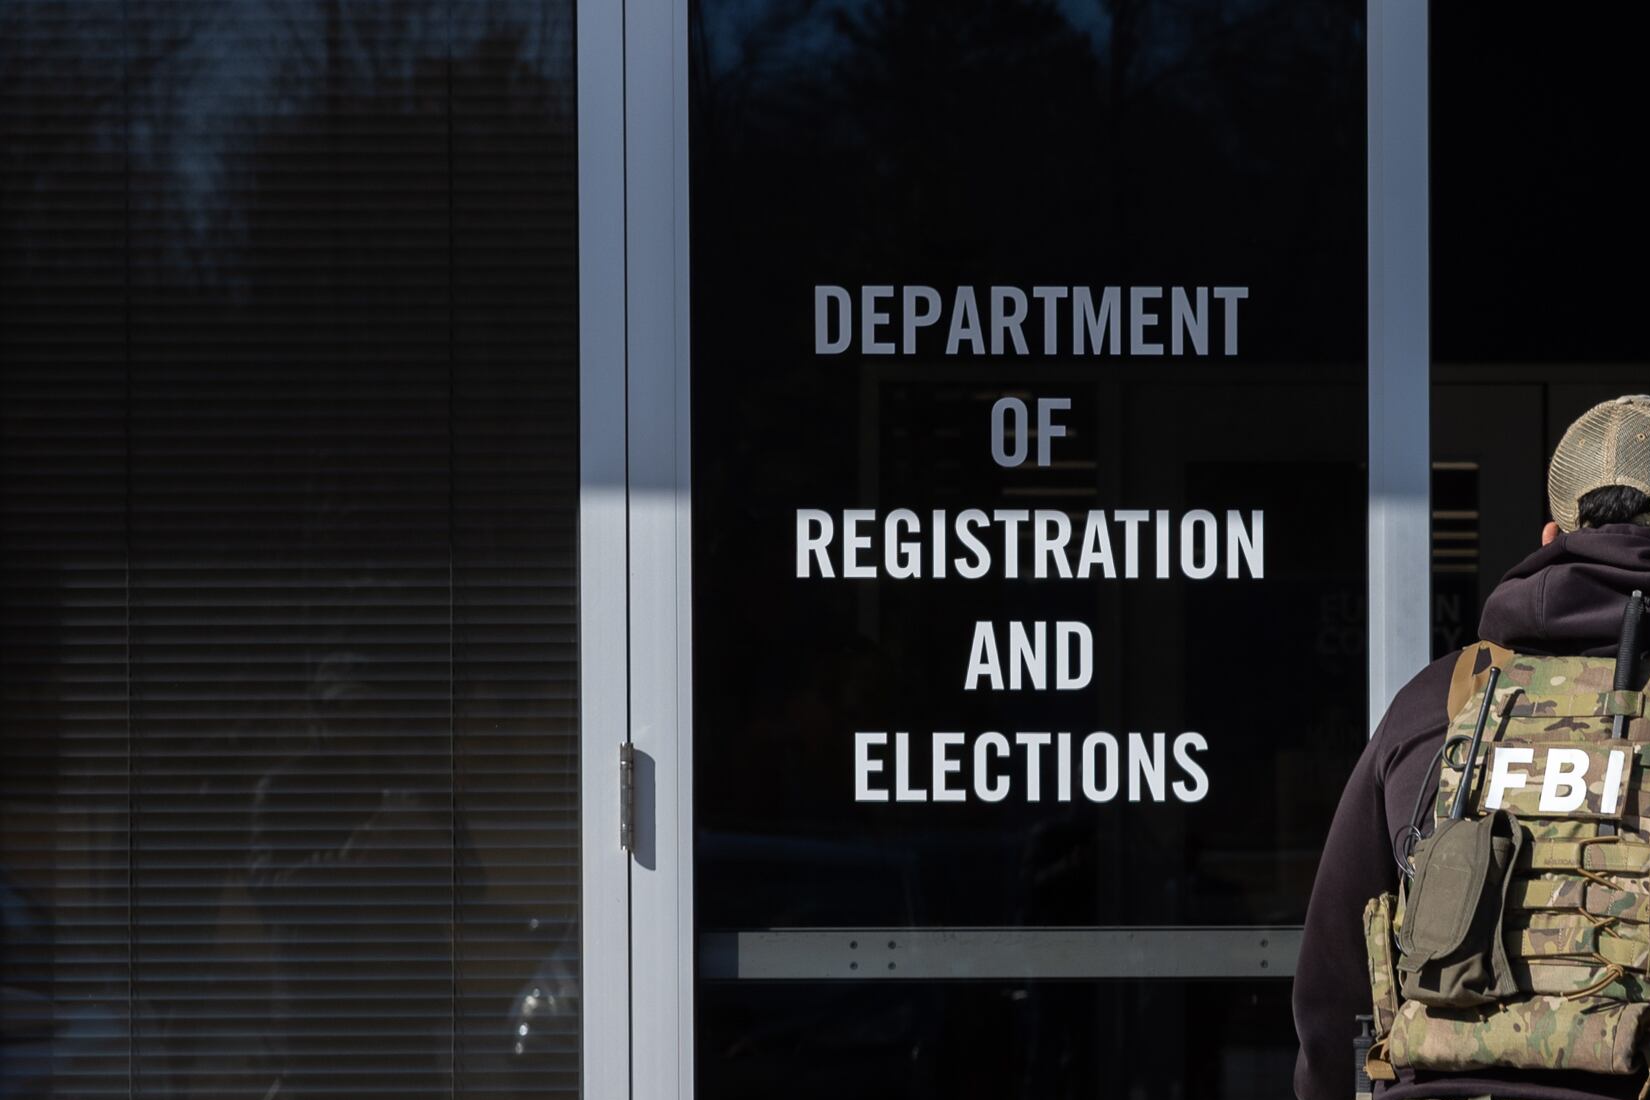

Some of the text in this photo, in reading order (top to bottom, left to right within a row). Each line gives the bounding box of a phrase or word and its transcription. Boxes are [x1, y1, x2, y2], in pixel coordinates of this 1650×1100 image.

[814, 285, 1249, 356] DEPARTMENT
[990, 396, 1072, 468] OF
[796, 508, 1264, 580] REGISTRATION
[963, 620, 1094, 691] AND
[854, 731, 1210, 803] ELECTIONS
[1484, 746, 1625, 815] FBI
